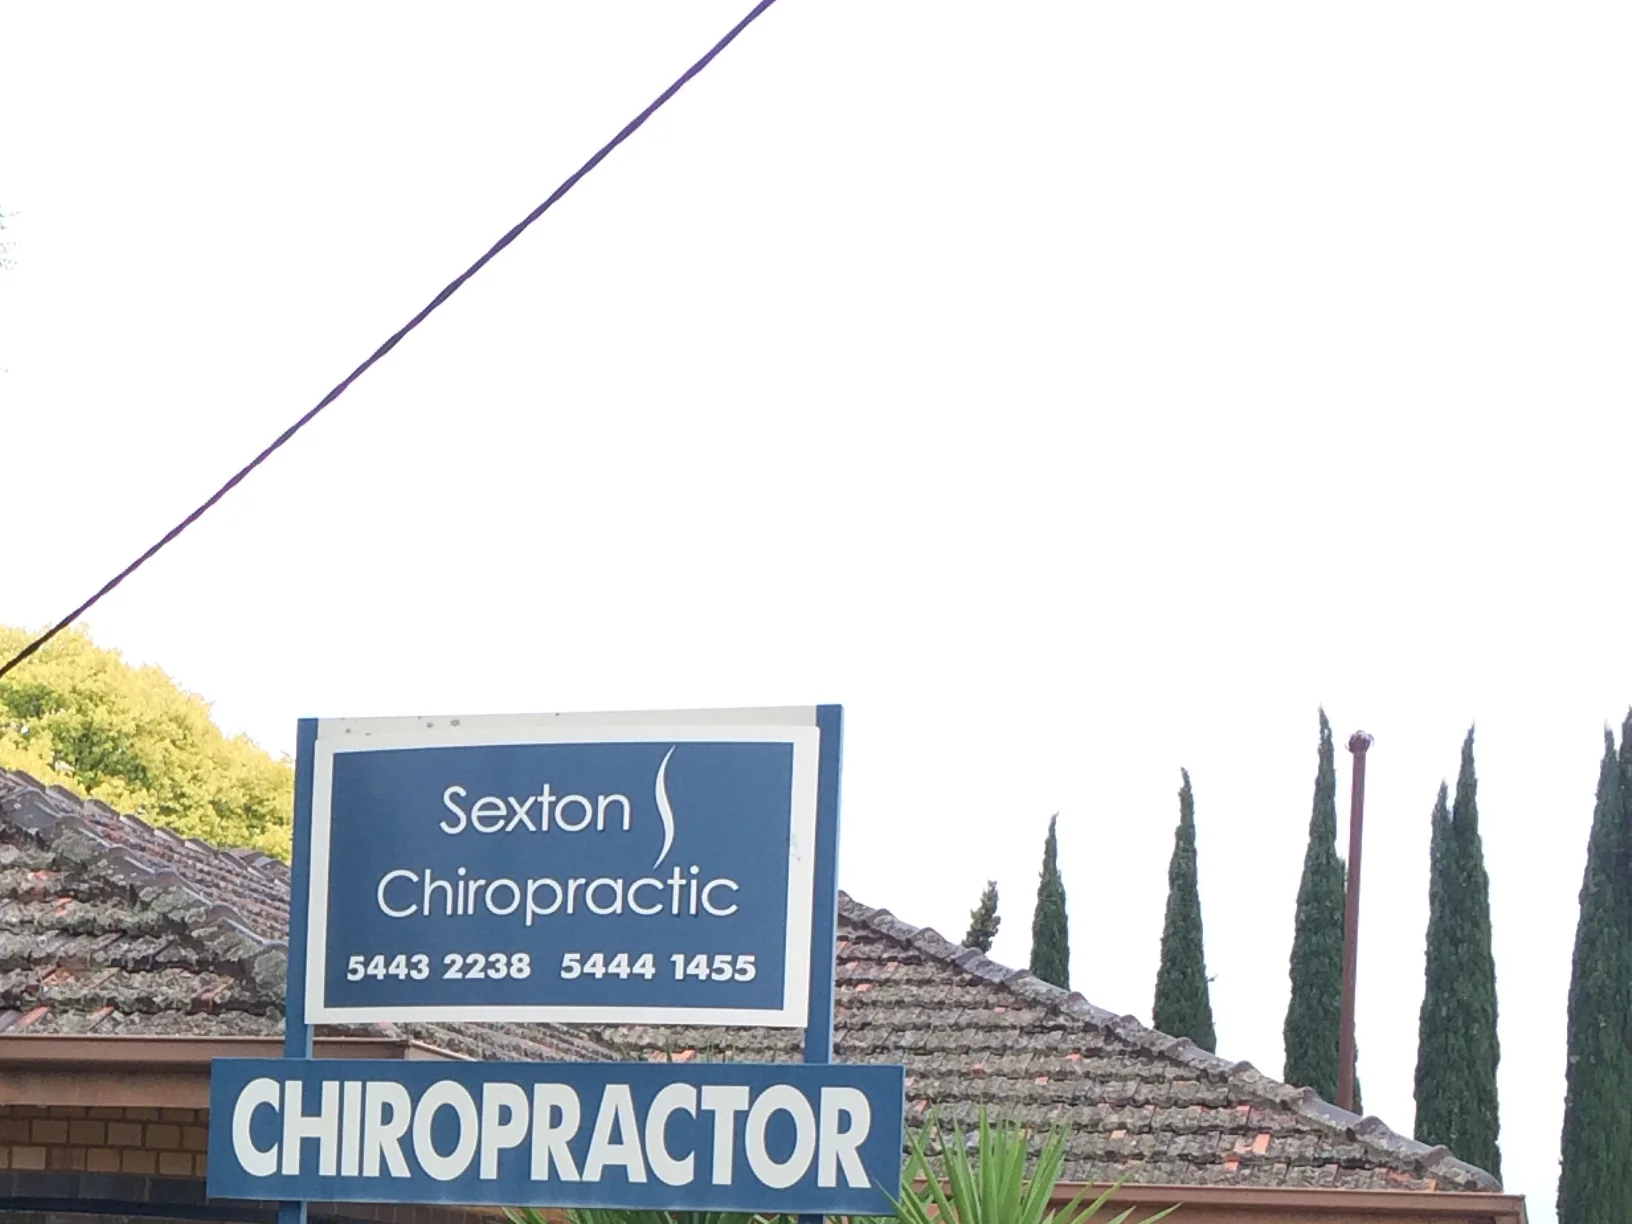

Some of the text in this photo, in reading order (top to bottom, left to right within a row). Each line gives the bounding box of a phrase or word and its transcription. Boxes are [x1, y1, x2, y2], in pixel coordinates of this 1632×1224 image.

[440, 784, 630, 835] Sexton
[377, 865, 740, 927] Chiropractic
[347, 952, 757, 982] 5443 2238 5444 1455
[232, 1077, 872, 1189] CHIROPRACTOR
